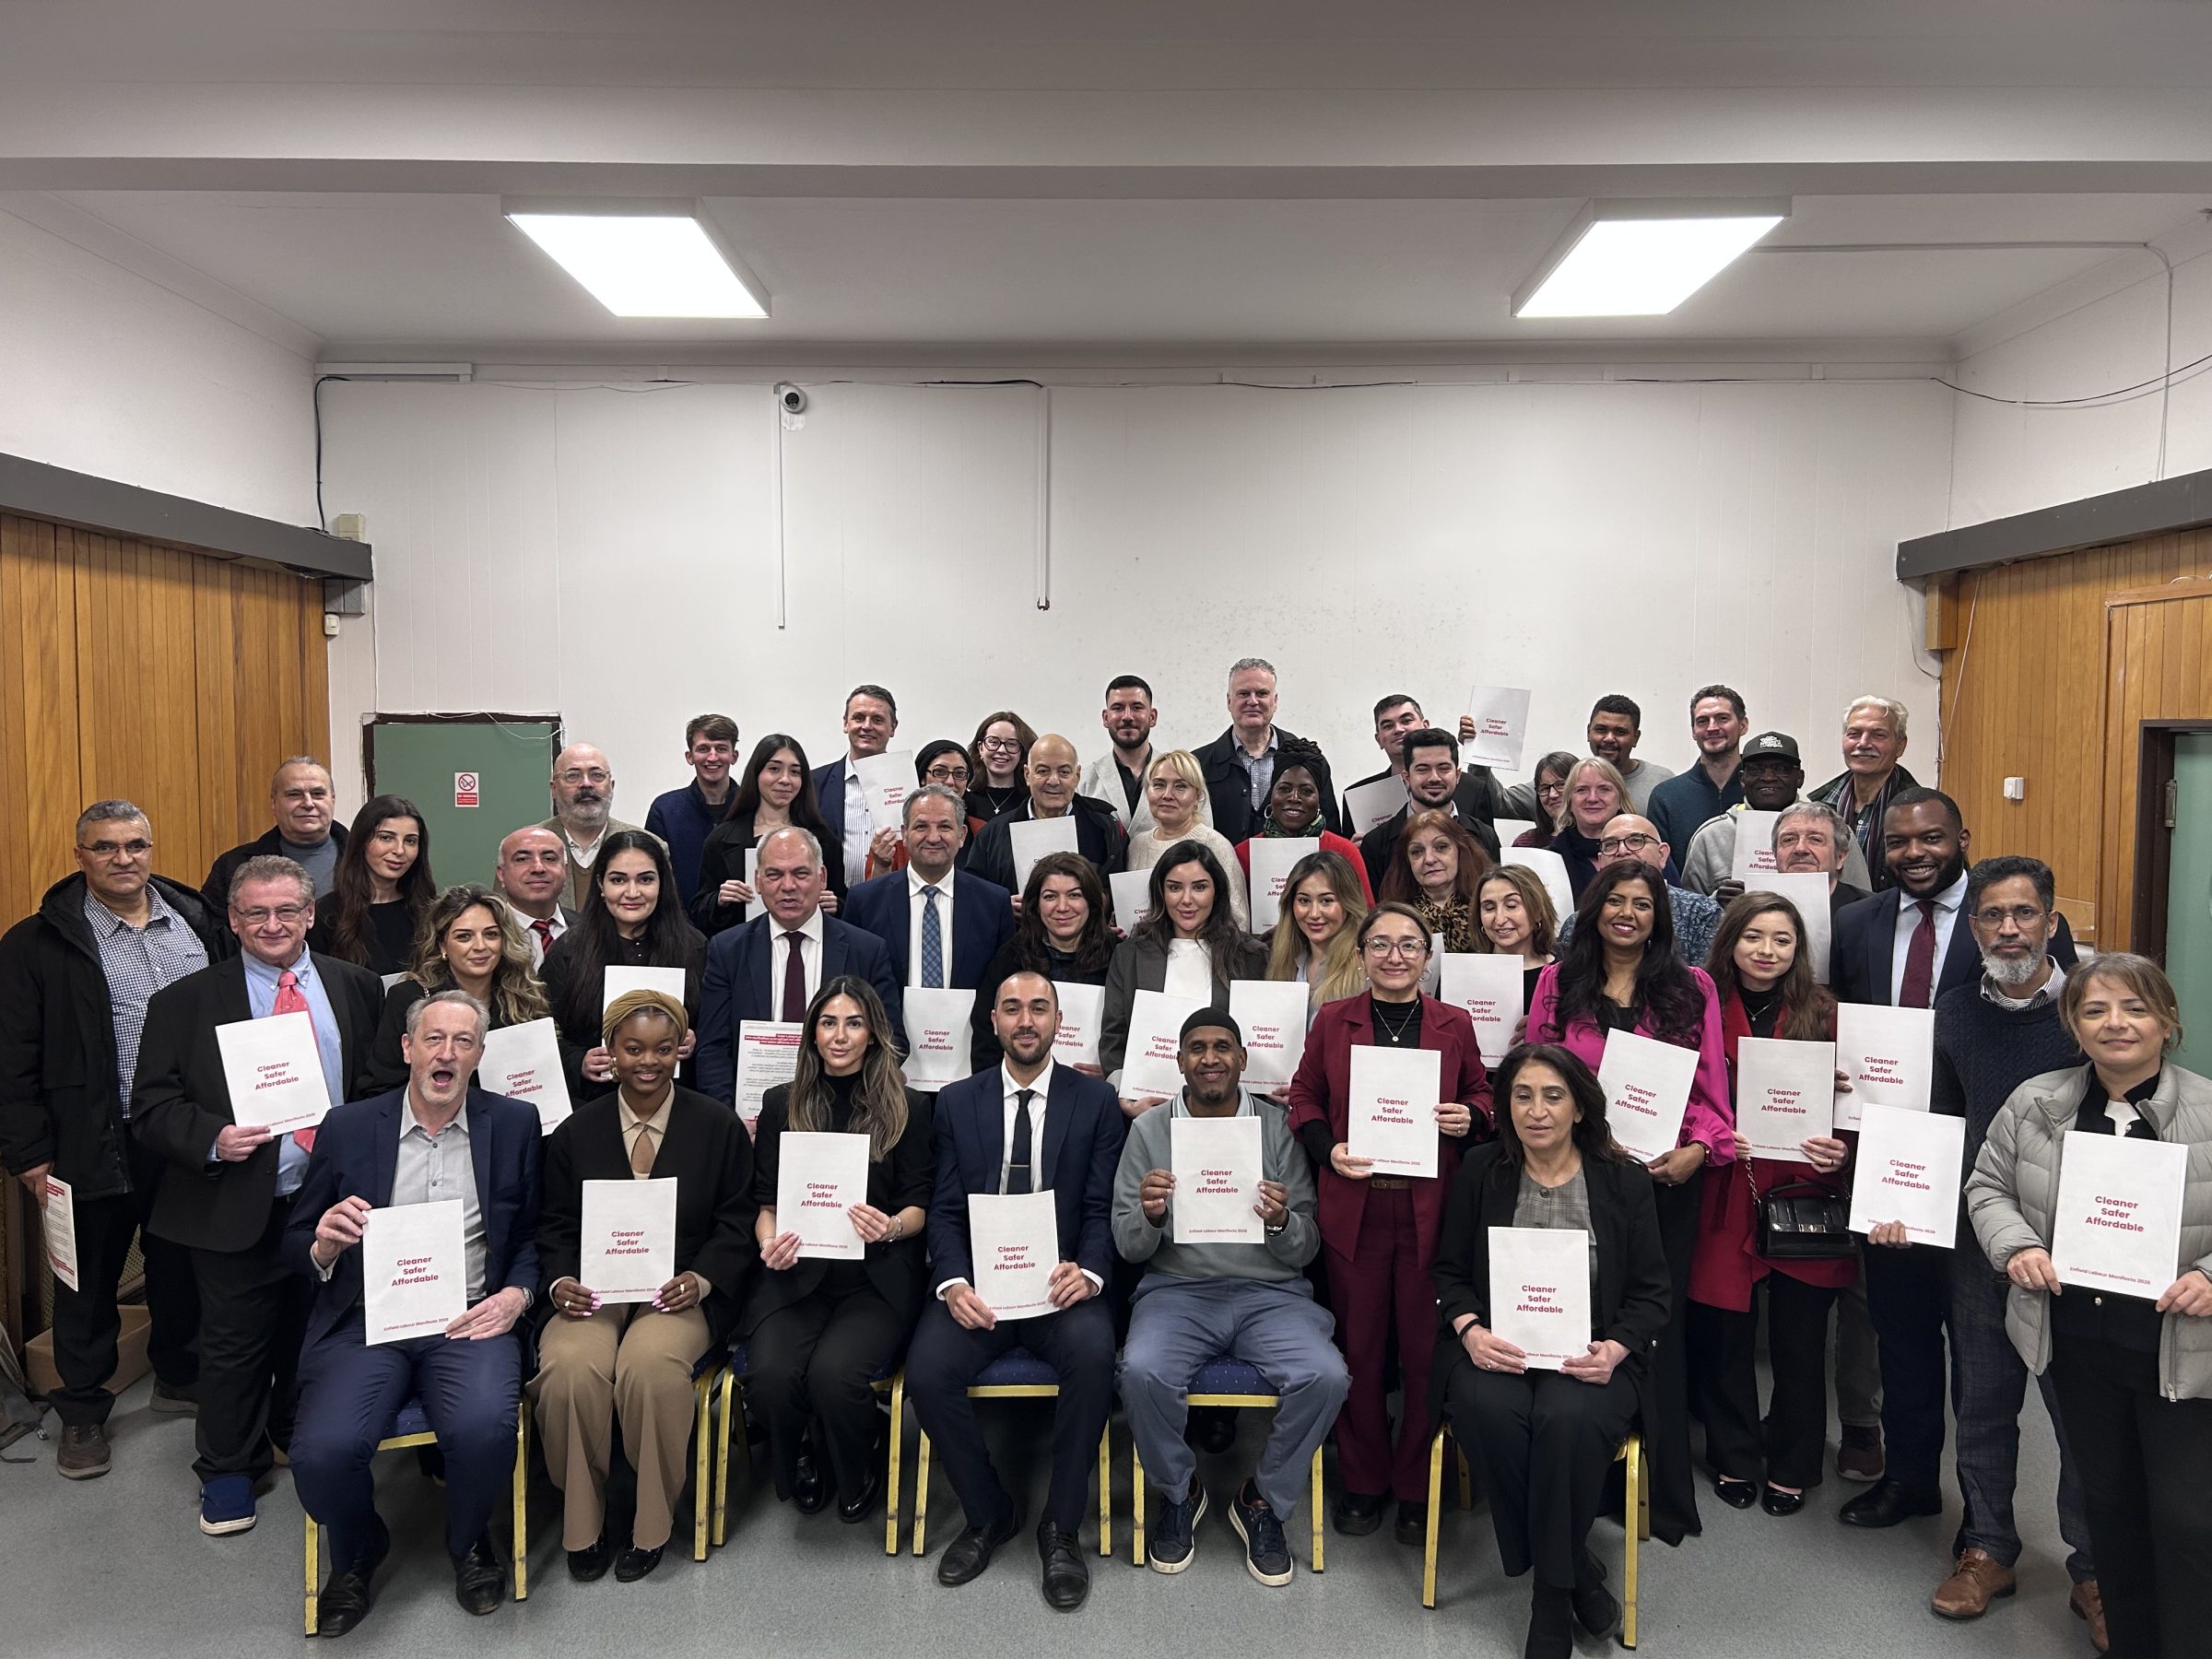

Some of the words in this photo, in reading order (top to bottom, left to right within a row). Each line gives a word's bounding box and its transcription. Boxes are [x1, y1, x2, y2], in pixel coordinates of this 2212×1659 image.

[1053, 1039, 1084, 1047] ffordable
[1152, 1036, 1178, 1044] Cleaner
[1145, 1051, 1177, 1060] Affordabl
[1864, 1056, 1899, 1066] Cleaner
[257, 1061, 290, 1073] Cleaner
[1869, 1065, 1892, 1075] Safer
[265, 1070, 287, 1079] Safer
[506, 1069, 535, 1080] Cleaner
[1858, 1074, 1904, 1085] Affordable
[255, 1076, 300, 1090] Affordable
[512, 1077, 532, 1088] Safer
[505, 1083, 543, 1098] Affordable
[1625, 1084, 1657, 1098] Cleaner
[1767, 1088, 1801, 1097] Cleaner
[1377, 1098, 1409, 1106] Cleaner
[1628, 1093, 1650, 1105] Safer
[1615, 1100, 1657, 1117] Affordable
[1761, 1105, 1806, 1114] Affordable
[1371, 1115, 1414, 1124] Affordable
[1889, 1159, 1926, 1171] Cleaner
[1894, 1170, 1919, 1179] Safer
[1881, 1176, 1930, 1190] Affordable
[801, 1200, 842, 1208] Affordable
[2095, 1195, 2138, 1209] Cleaner
[2100, 1207, 2130, 1218] Safer
[2085, 1217, 2144, 1232] Affordable
[606, 1247, 650, 1255] Affordable
[397, 1256, 432, 1266] Cleaner
[403, 1266, 428, 1275] Safer
[994, 1262, 1036, 1271] Affordable
[392, 1274, 439, 1287] Affordable
[1522, 1285, 1557, 1293] Cleaner
[1527, 1295, 1551, 1303] Safer
[1516, 1304, 1563, 1313] Affordable
